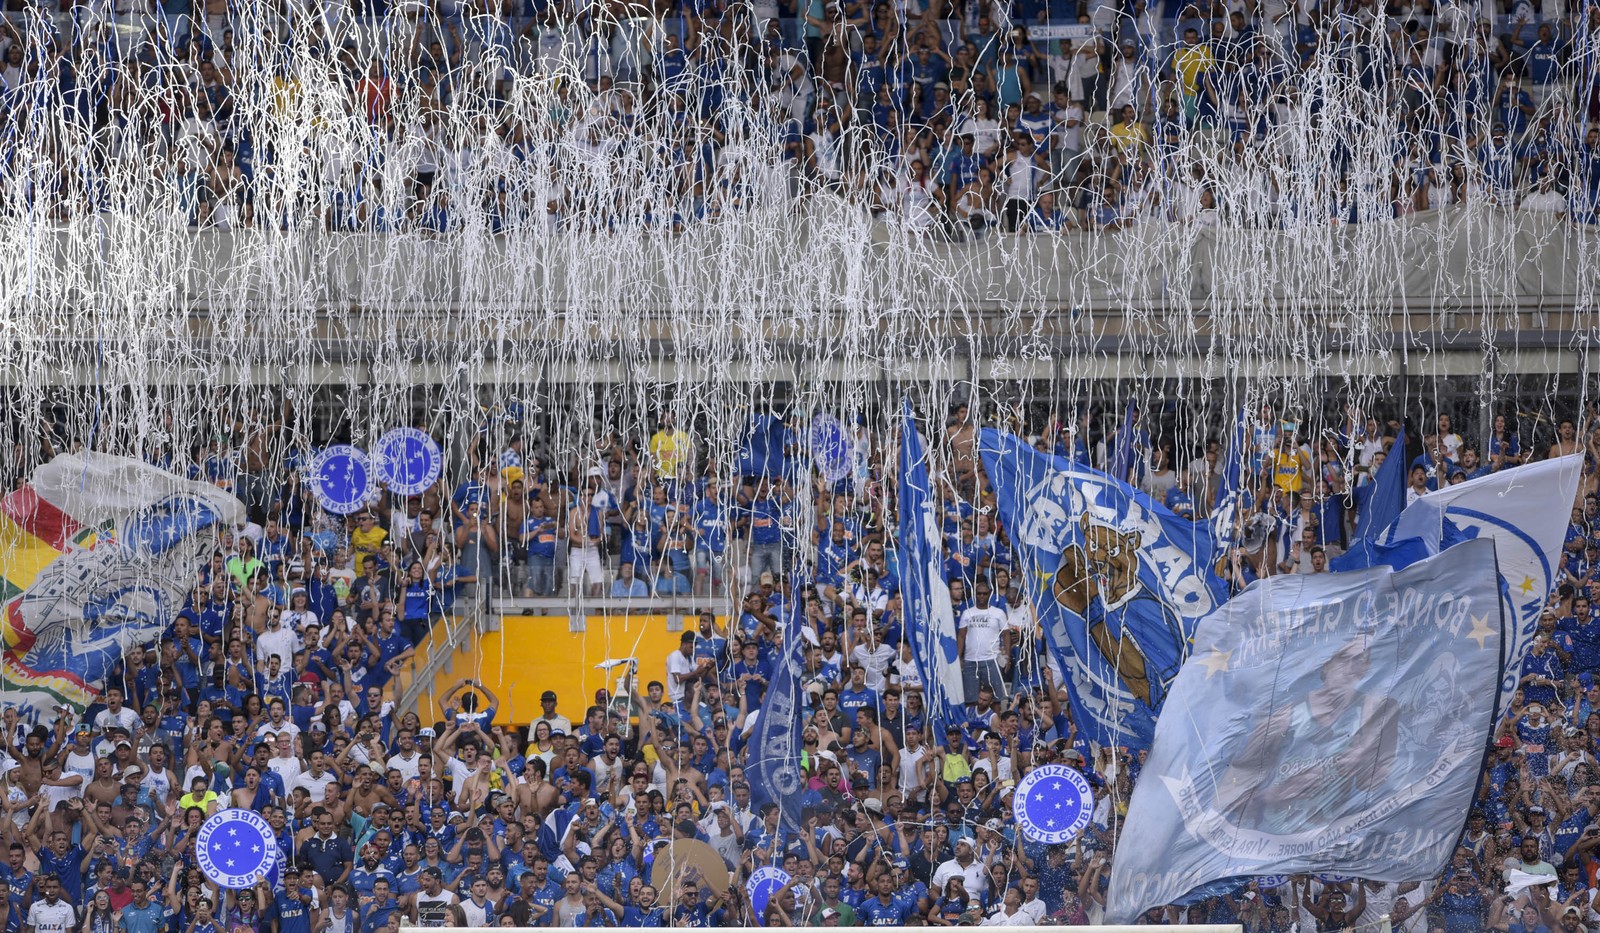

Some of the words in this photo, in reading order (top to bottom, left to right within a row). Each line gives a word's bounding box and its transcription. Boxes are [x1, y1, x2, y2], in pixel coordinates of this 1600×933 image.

[842, 700, 867, 708] CAIXA
[137, 746, 150, 754] CAI
[1026, 765, 1089, 795] CRUZEIRO
[231, 810, 273, 841] CLUBE
[1016, 792, 1055, 842] ESPORTE
[1059, 801, 1092, 841] CLUBE
[1556, 826, 1579, 835] AIXA
[197, 815, 224, 880] CRUZEIRO
[227, 843, 276, 886] ESPORTE
[281, 908, 303, 918] CAIXA
[872, 917, 898, 925] CAIXA
[38, 923, 63, 931] CAIXA
